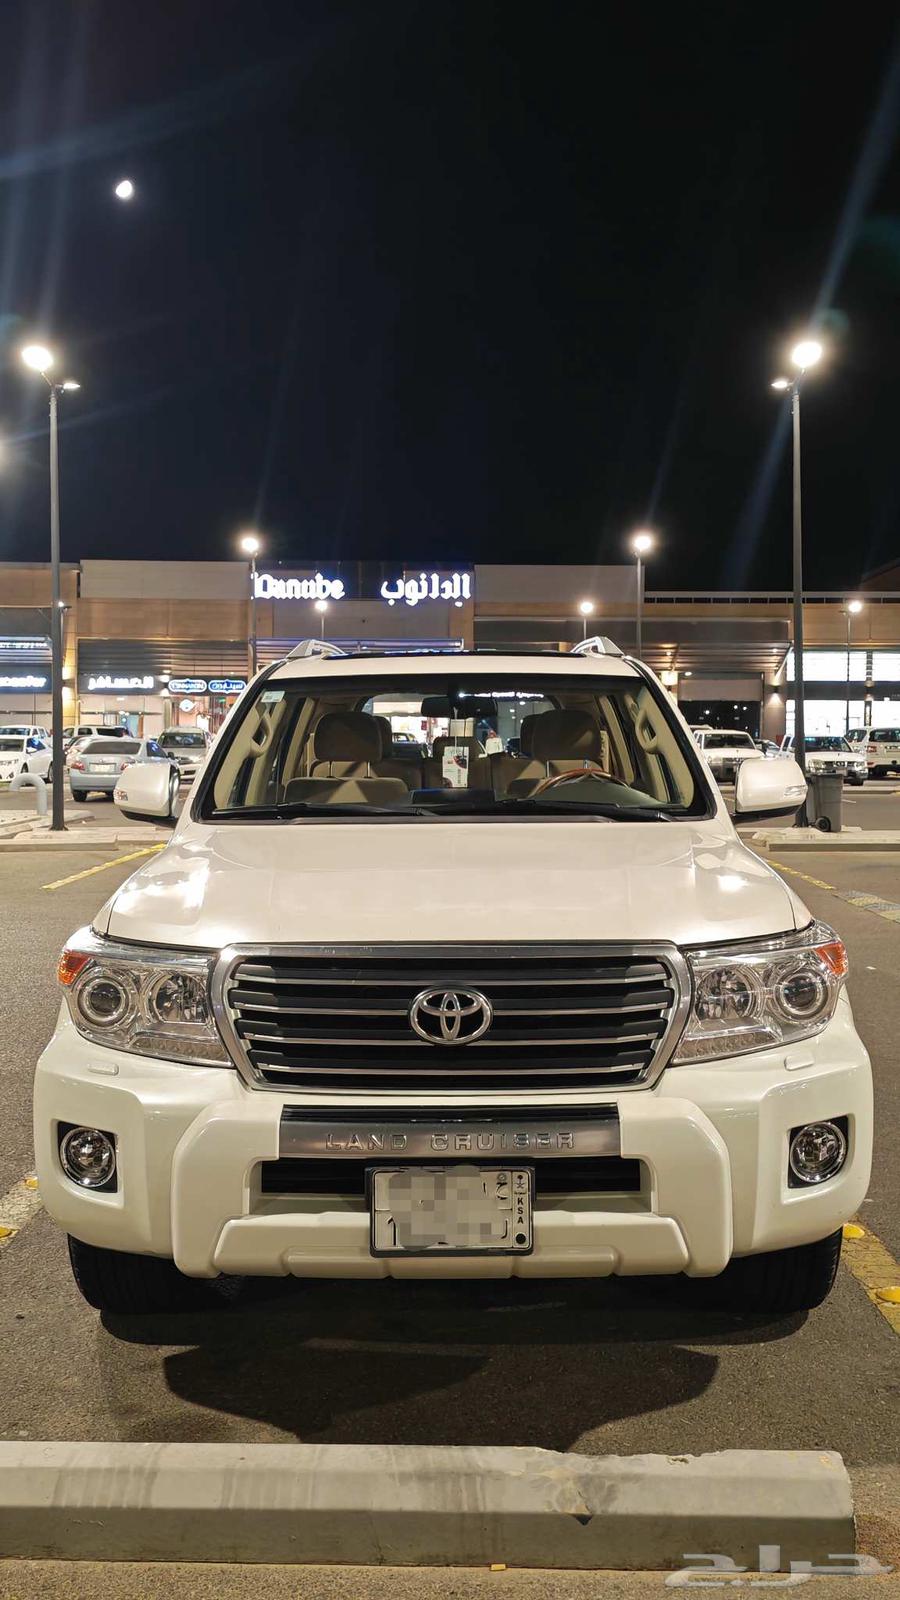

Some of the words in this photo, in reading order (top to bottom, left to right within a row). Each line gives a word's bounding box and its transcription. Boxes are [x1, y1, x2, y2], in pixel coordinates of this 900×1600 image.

[252, 572, 346, 600] Danube
[380, 572, 471, 607] الدانوب
[325, 1133, 409, 1151] LAND
[430, 1132, 574, 1151] CRUISER
